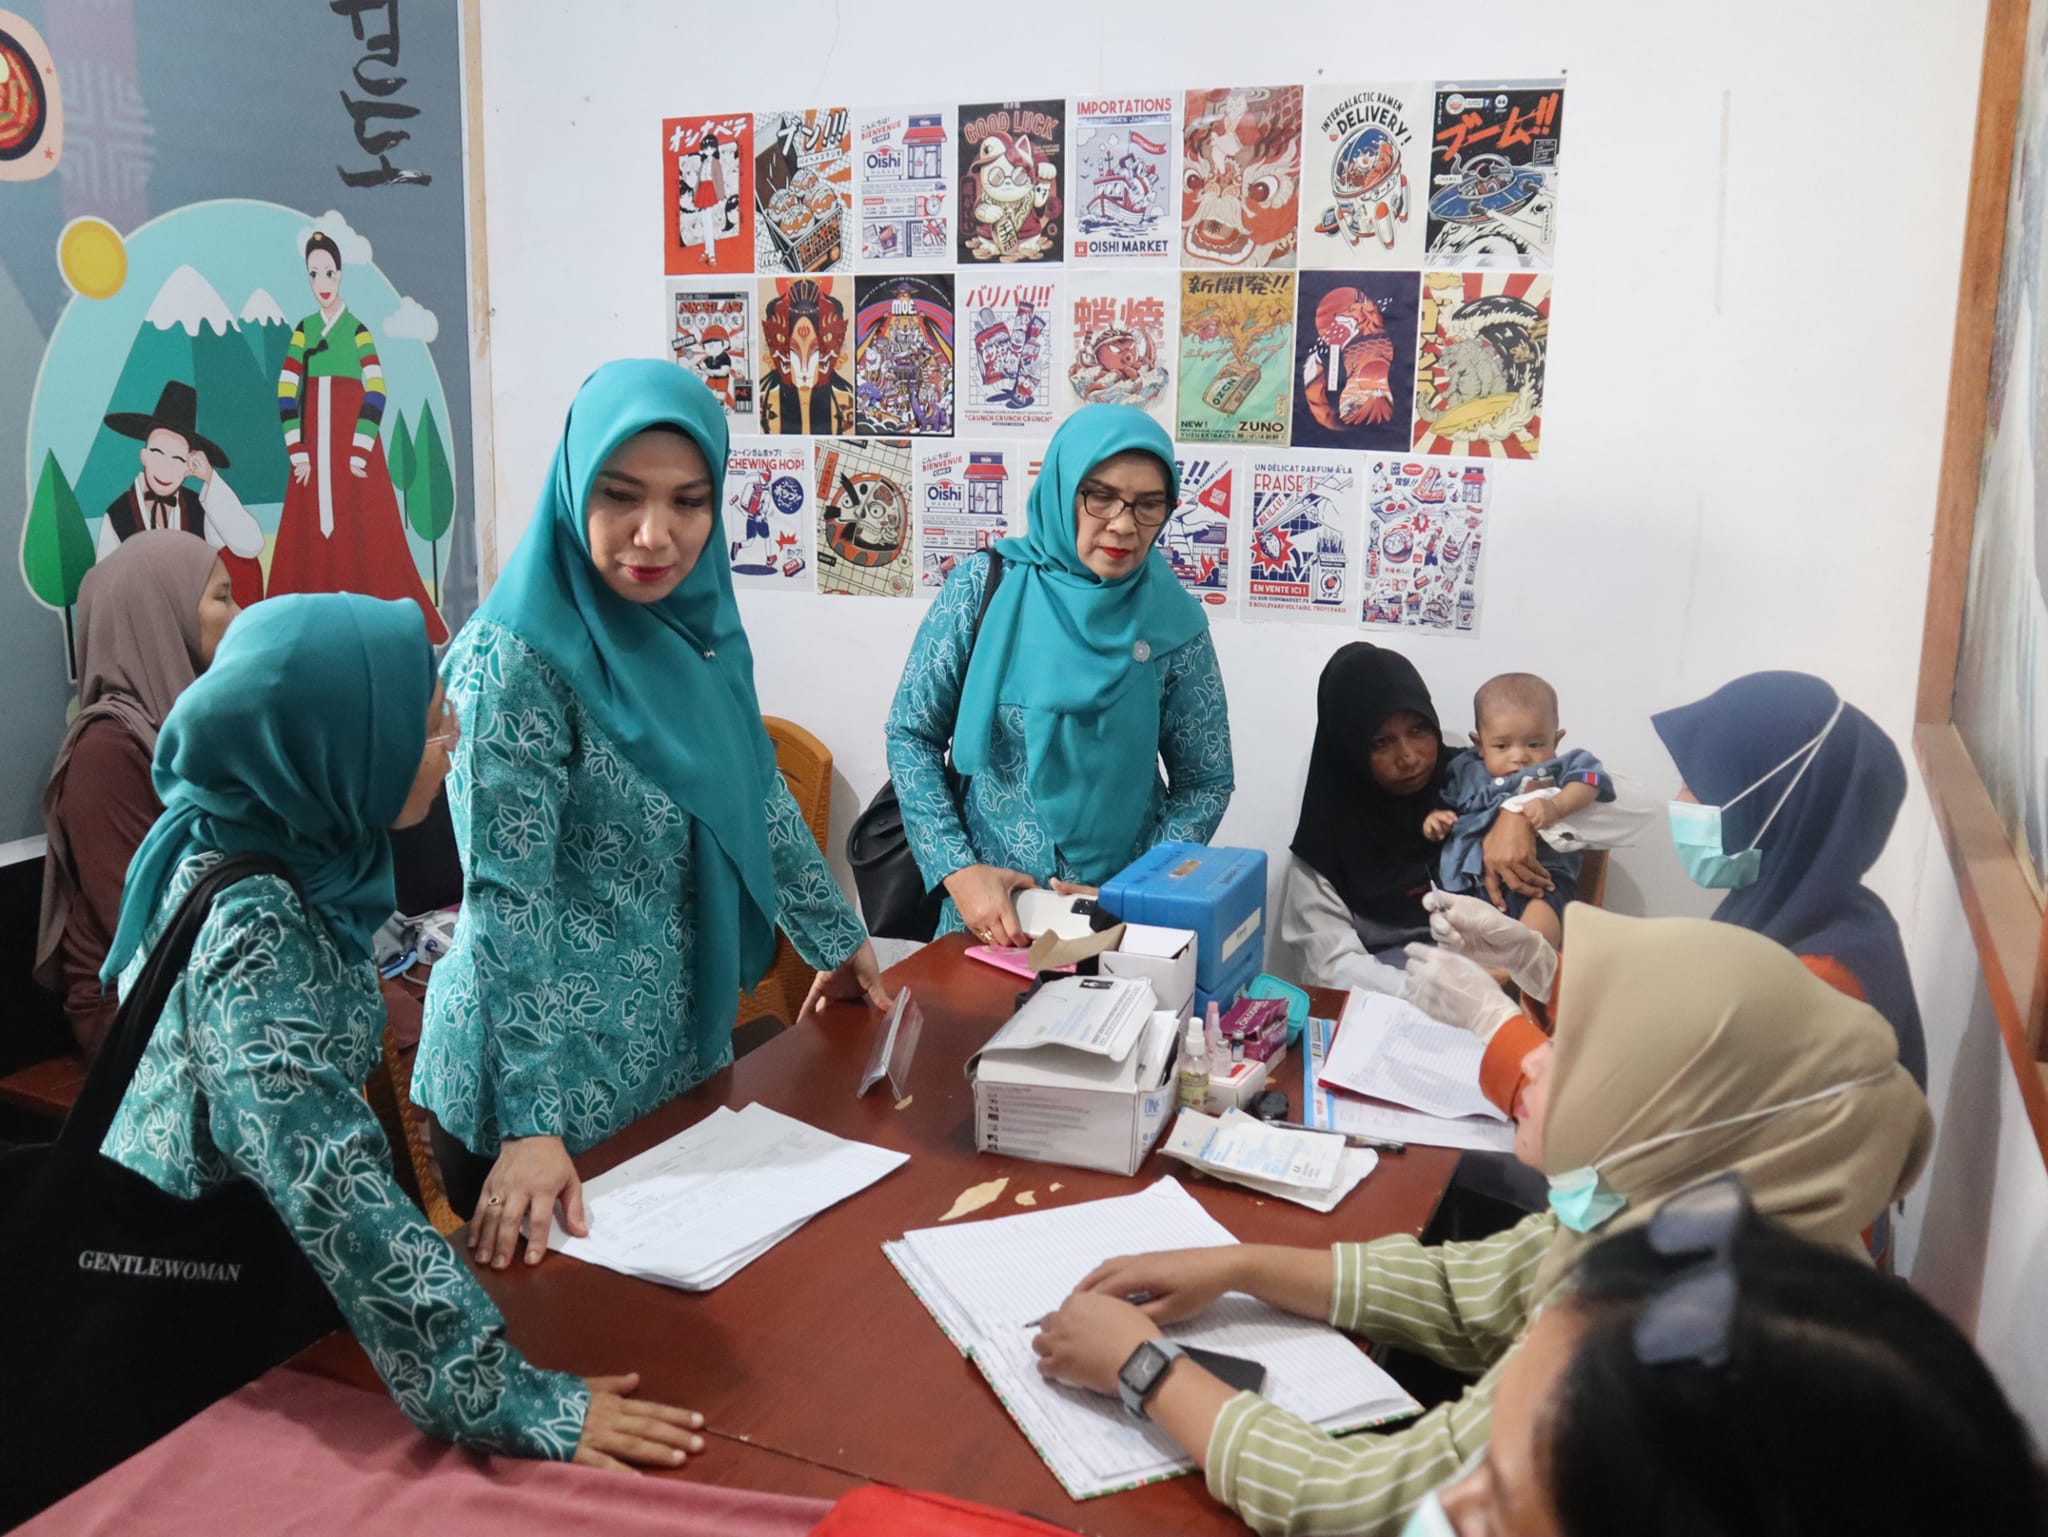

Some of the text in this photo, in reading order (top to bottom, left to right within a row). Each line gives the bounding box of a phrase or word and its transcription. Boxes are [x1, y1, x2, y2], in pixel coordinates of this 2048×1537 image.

[1077, 97, 1172, 116] IMPORTATIONS
[1321, 91, 1375, 132] INTERGALACTIC
[1377, 92, 1403, 112] RAMEN
[861, 120, 902, 141] BIENVENUE
[964, 110, 1059, 144] GOOD LUCK
[1336, 105, 1412, 146] DELIVERY!
[866, 152, 901, 169] Oishi
[1089, 241, 1119, 253] OISHI
[1121, 240, 1168, 252] MARKET
[1239, 421, 1284, 433] ZUNO
[728, 458, 805, 471] CHEWING HOP!
[922, 456, 963, 472] BIENVENUE
[1255, 464, 1266, 472] UN
[1267, 463, 1299, 473] DÉLICAT
[1301, 465, 1334, 474] PARFUM
[1254, 474, 1304, 492] FRAISE
[928, 486, 962, 500] Oishi
[1253, 584, 1264, 592] EN
[1265, 585, 1290, 594] VENTE
[1291, 586, 1302, 594] ICI
[79, 1250, 242, 1282] GENTLEWOMAN
